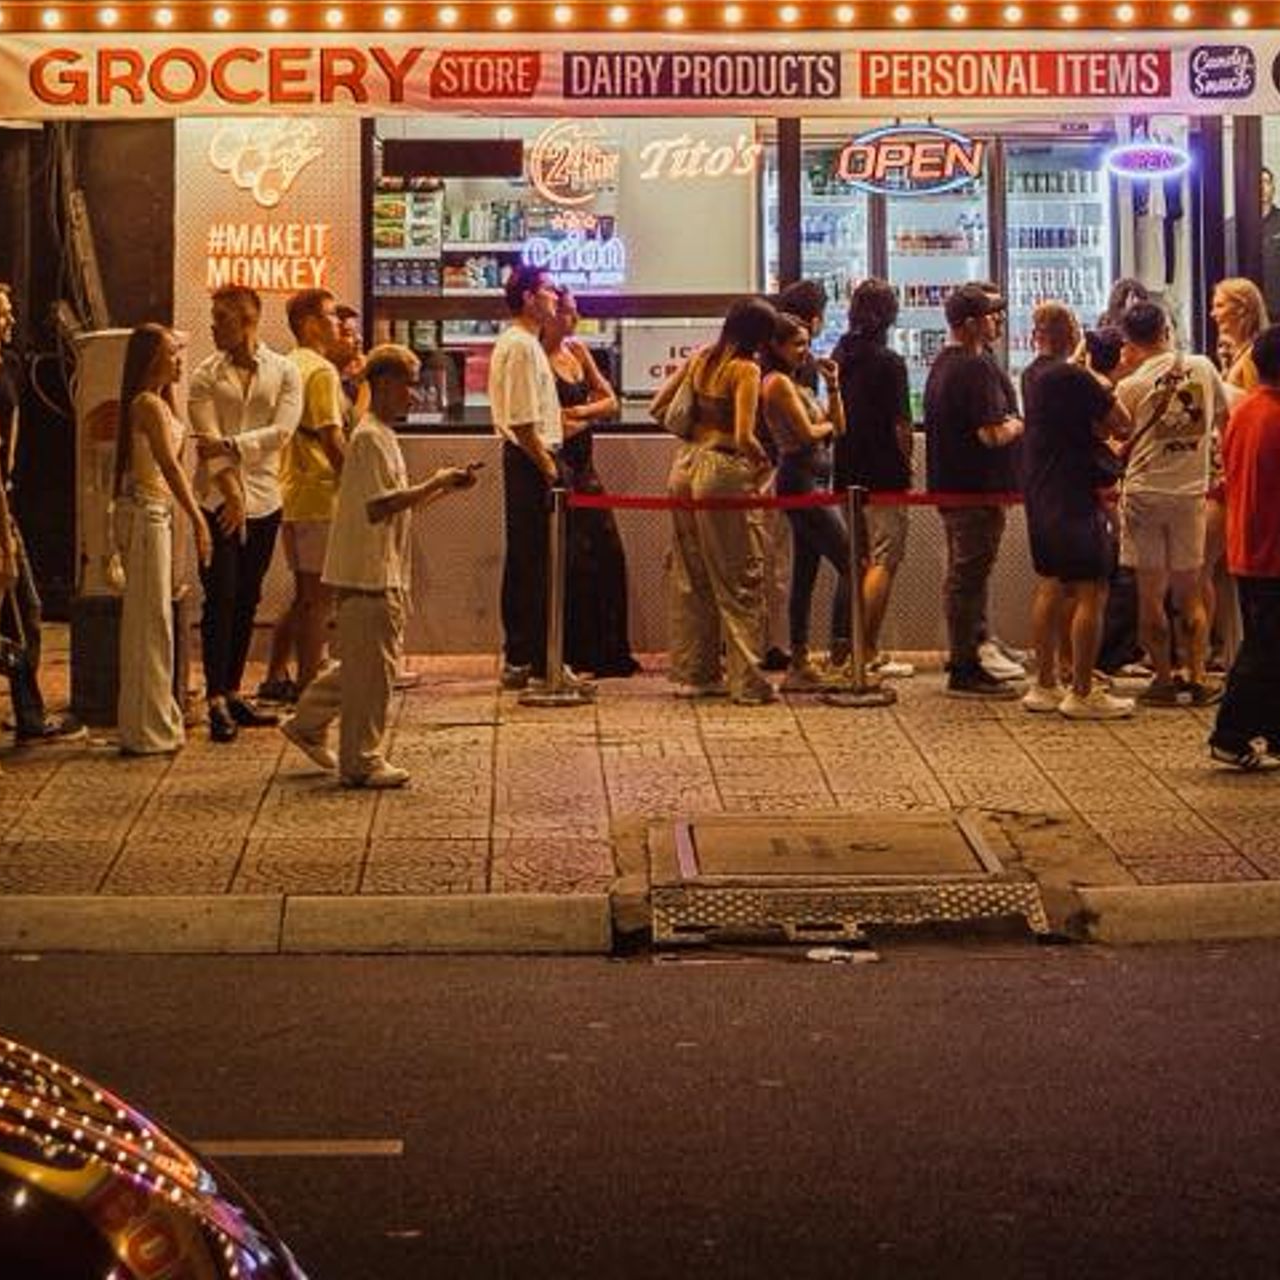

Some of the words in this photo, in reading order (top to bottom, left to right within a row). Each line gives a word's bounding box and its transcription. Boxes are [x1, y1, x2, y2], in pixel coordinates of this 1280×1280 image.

[29, 47, 425, 106] GROCERY
[438, 54, 534, 94] STORE
[570, 54, 666, 95] DAIRY
[672, 54, 836, 96] PRODUCTS
[868, 54, 1049, 96] PERSONAL
[1057, 54, 1160, 94] ITEMS
[640, 134, 762, 180] Tito's
[837, 138, 983, 181] OPEN
[207, 256, 327, 289] MONKEY
[669, 346, 692, 359] IC
